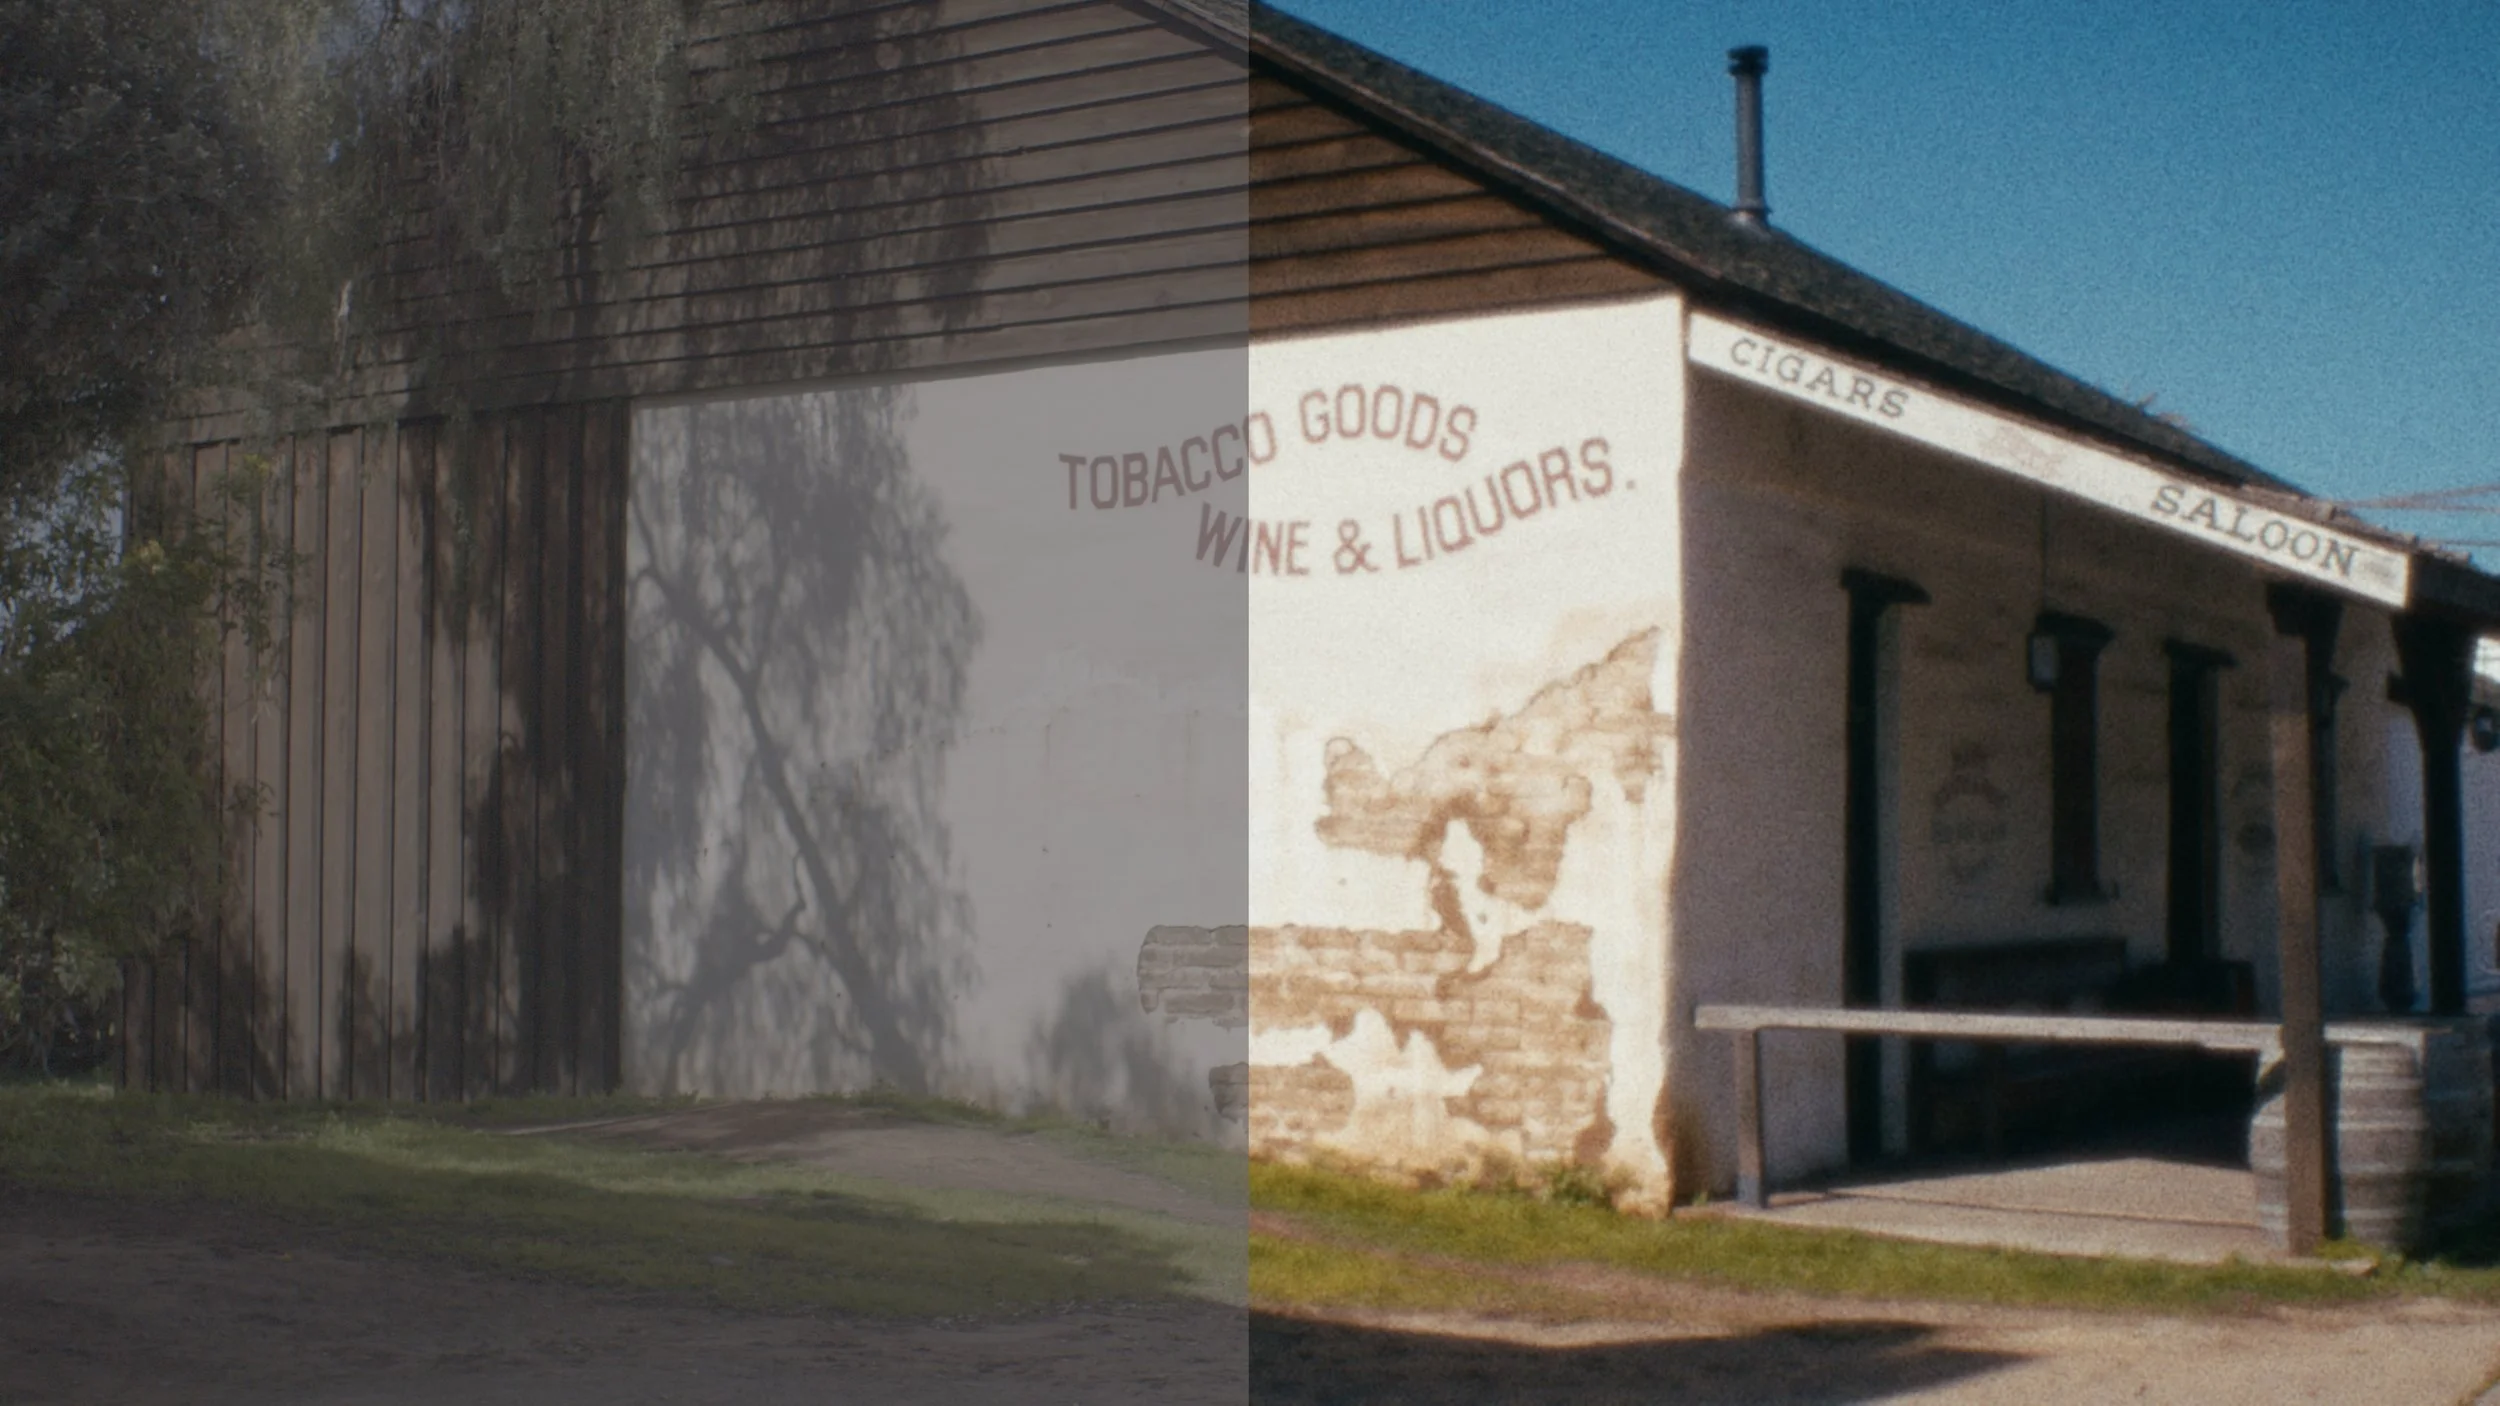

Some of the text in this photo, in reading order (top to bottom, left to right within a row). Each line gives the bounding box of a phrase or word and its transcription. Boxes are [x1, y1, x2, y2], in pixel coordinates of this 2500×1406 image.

[1730, 337, 1910, 418] CIGARS
[1058, 383, 1478, 511] TOBACCO GOODS
[1195, 436, 1637, 576] WINE & LIQUORS.
[2151, 483, 2359, 578] SALOON
